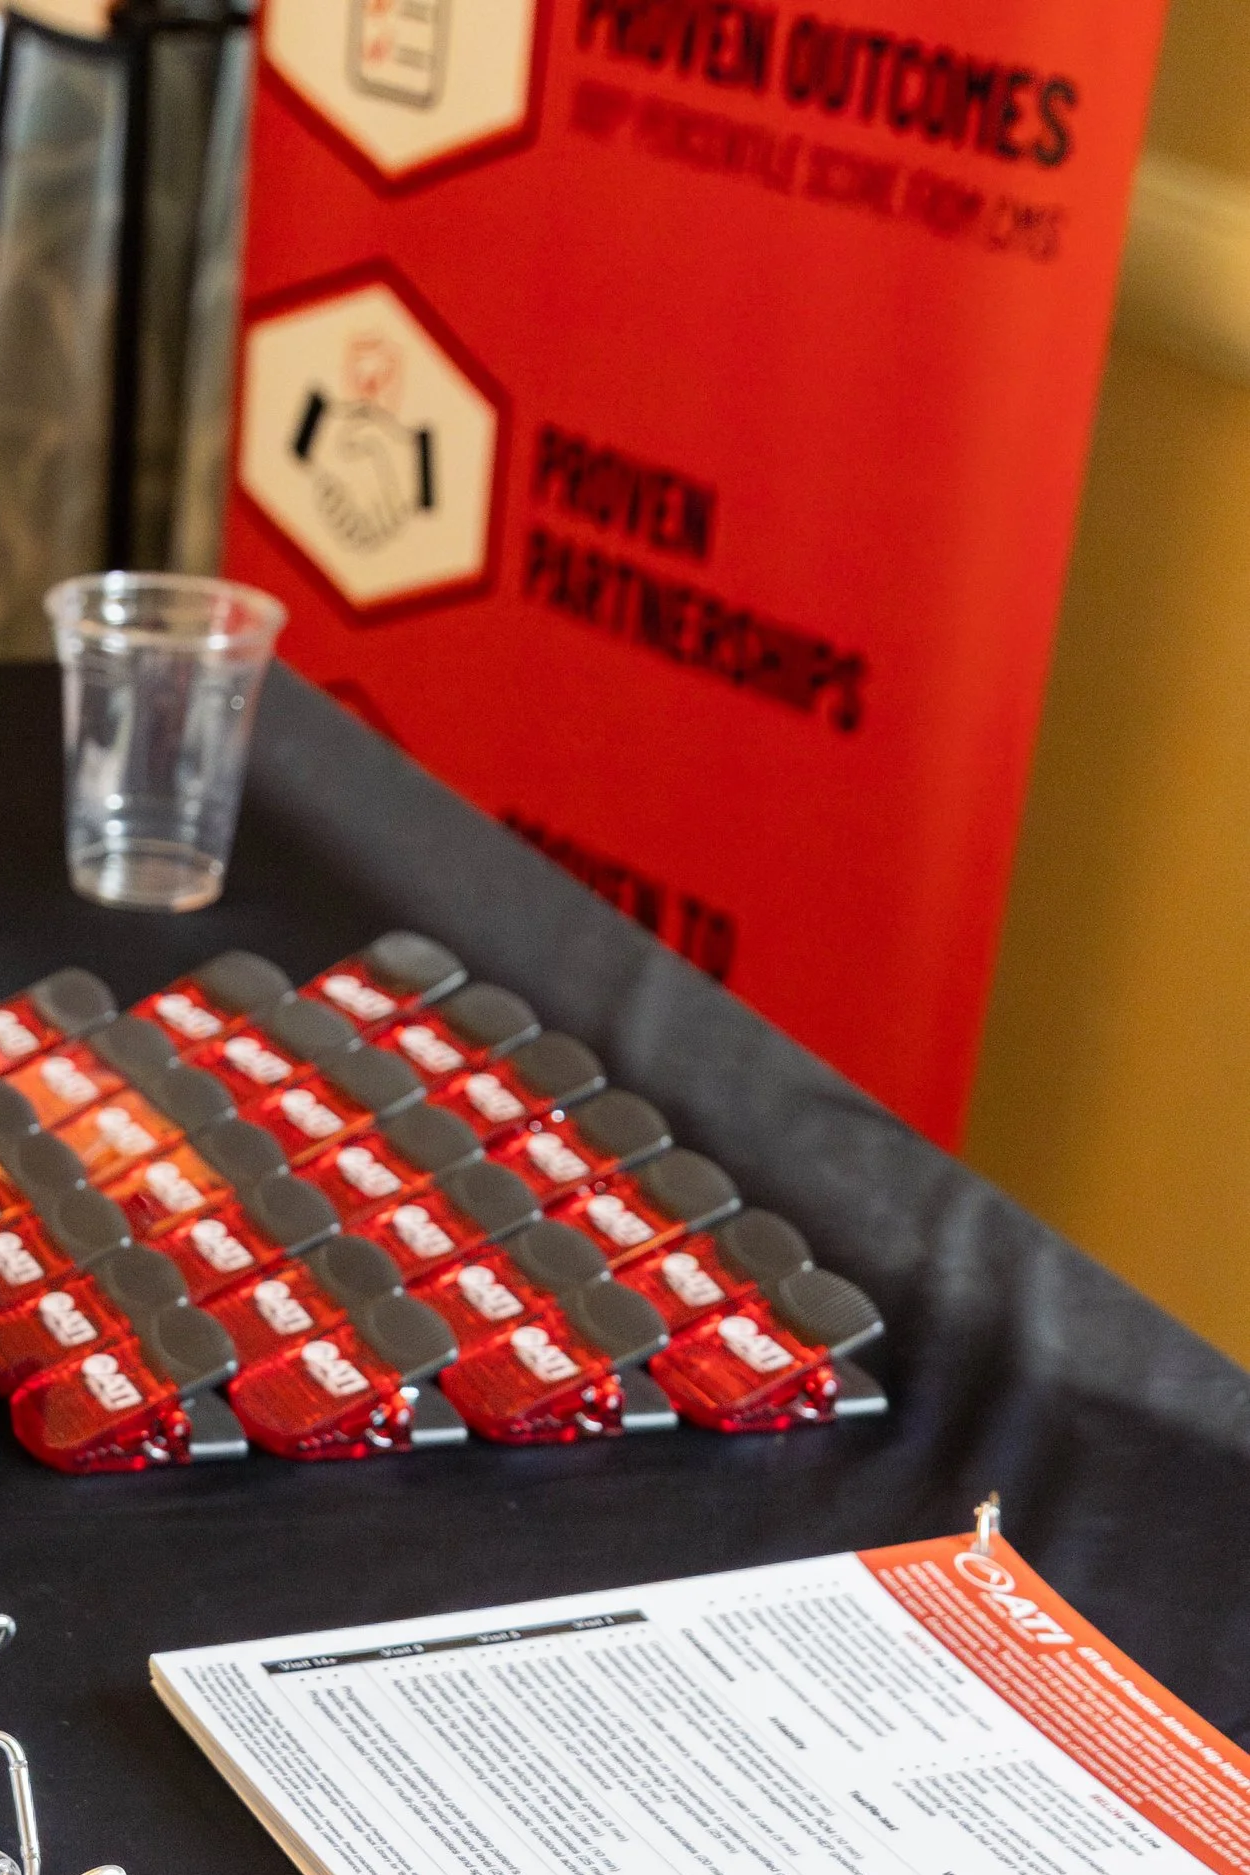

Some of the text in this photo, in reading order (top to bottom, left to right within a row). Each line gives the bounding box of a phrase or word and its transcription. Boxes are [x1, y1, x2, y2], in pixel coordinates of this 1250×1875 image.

[784, 15, 1078, 168] OUTCOMES
[536, 426, 716, 563] PROVEN
[525, 525, 866, 732] PARTNERSHIPS
[989, 1590, 1075, 1645] ATI
